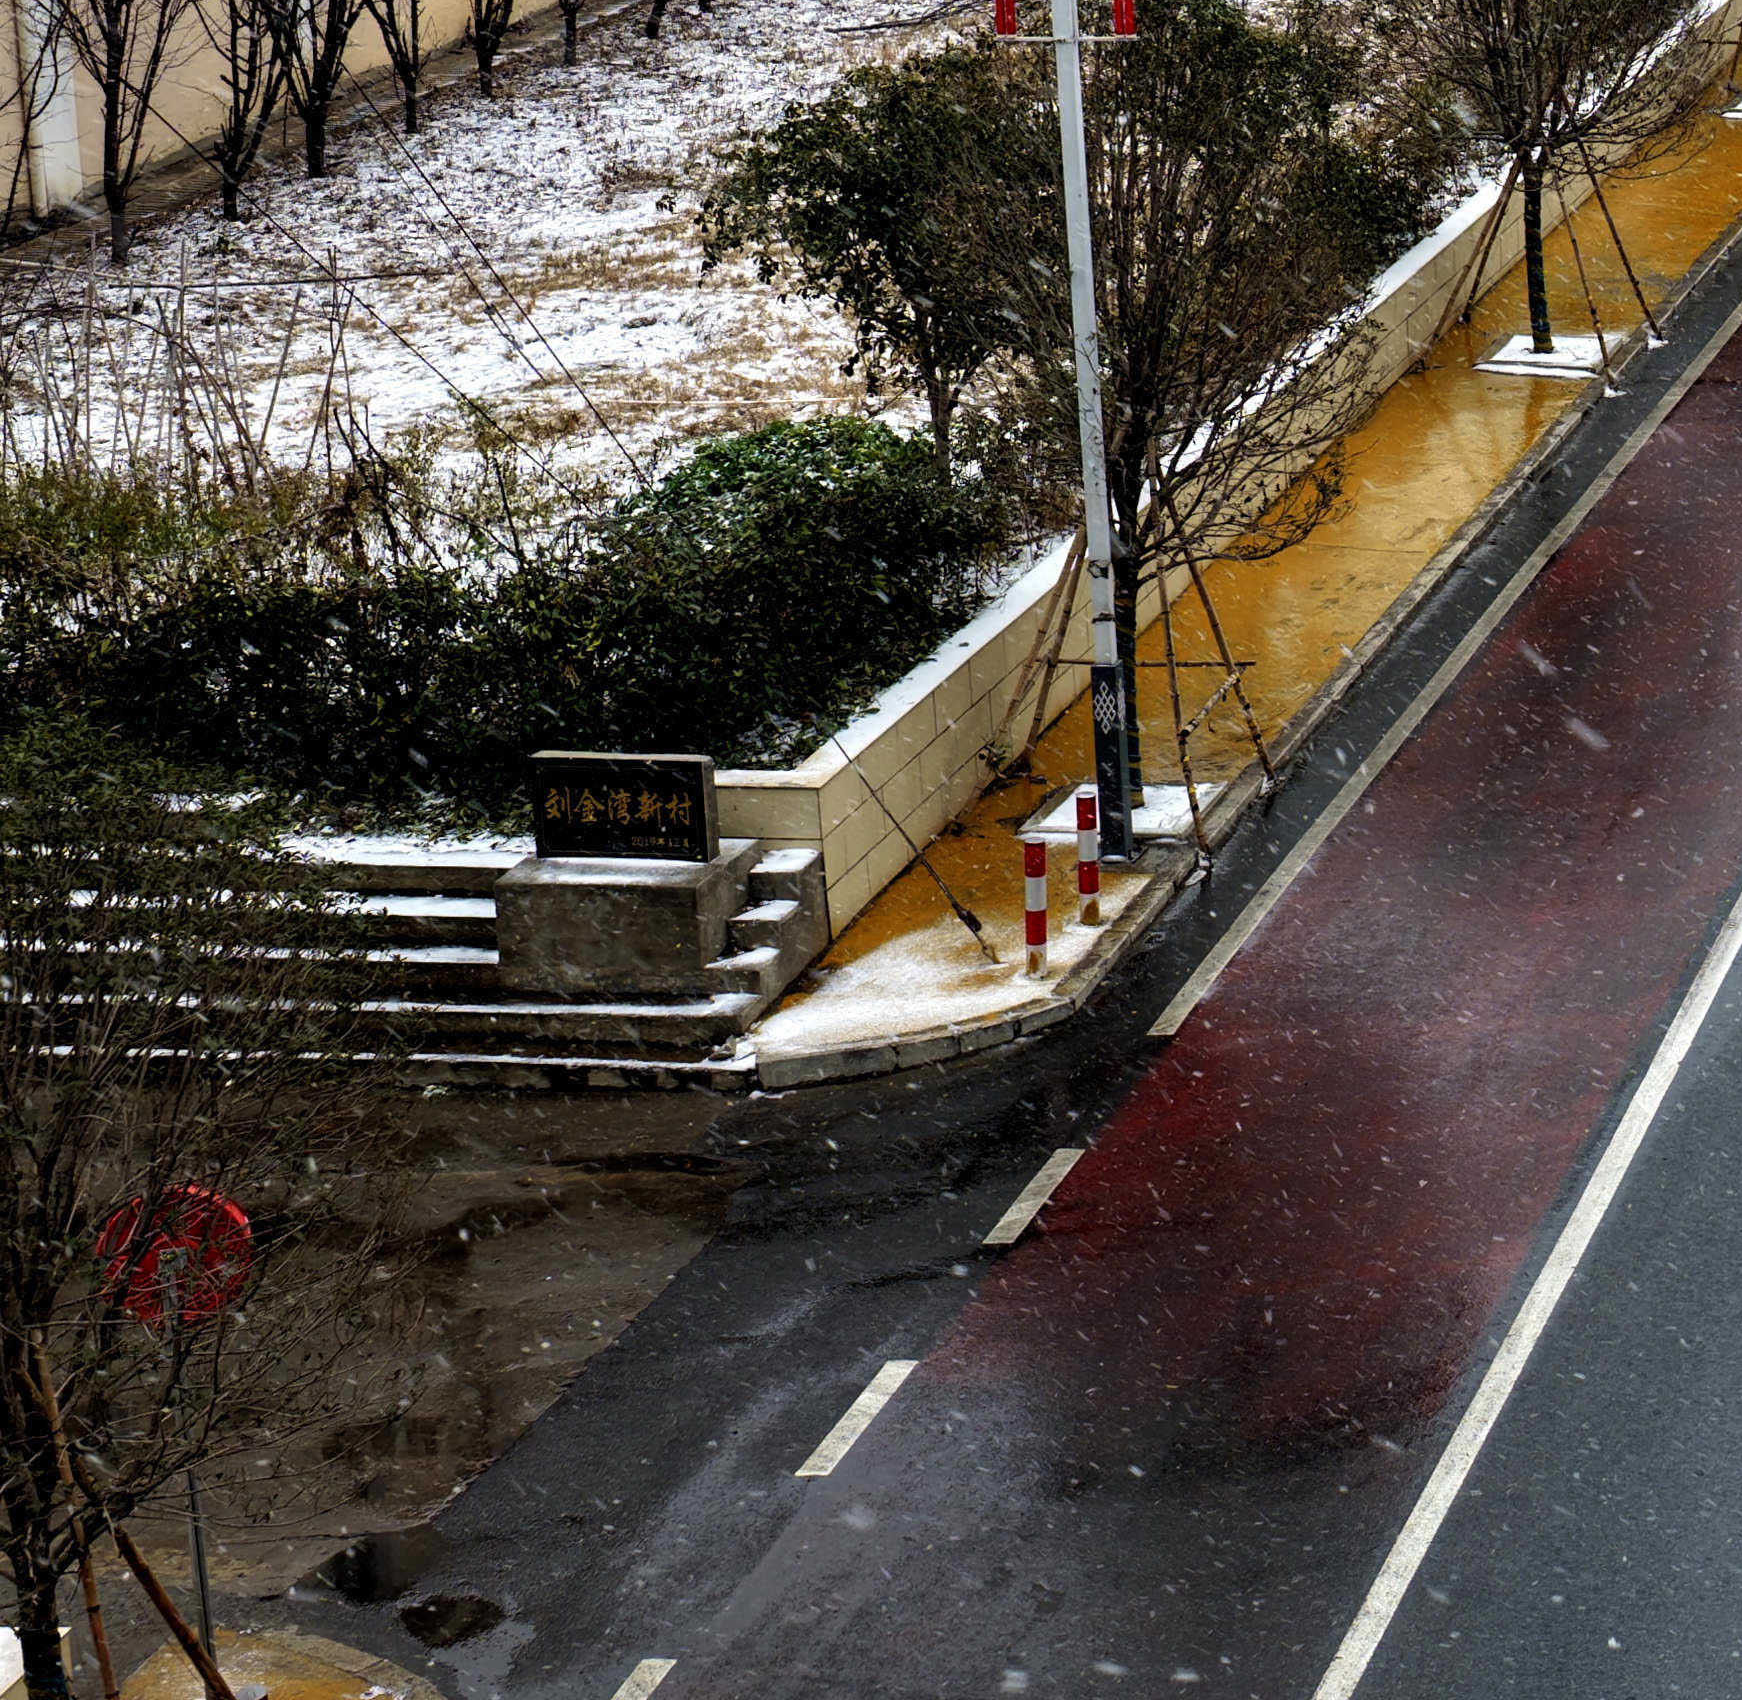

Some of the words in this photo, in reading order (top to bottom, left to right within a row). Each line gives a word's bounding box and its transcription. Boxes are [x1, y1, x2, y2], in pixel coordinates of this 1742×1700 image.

[543, 786, 693, 828] 刘金湾新村
